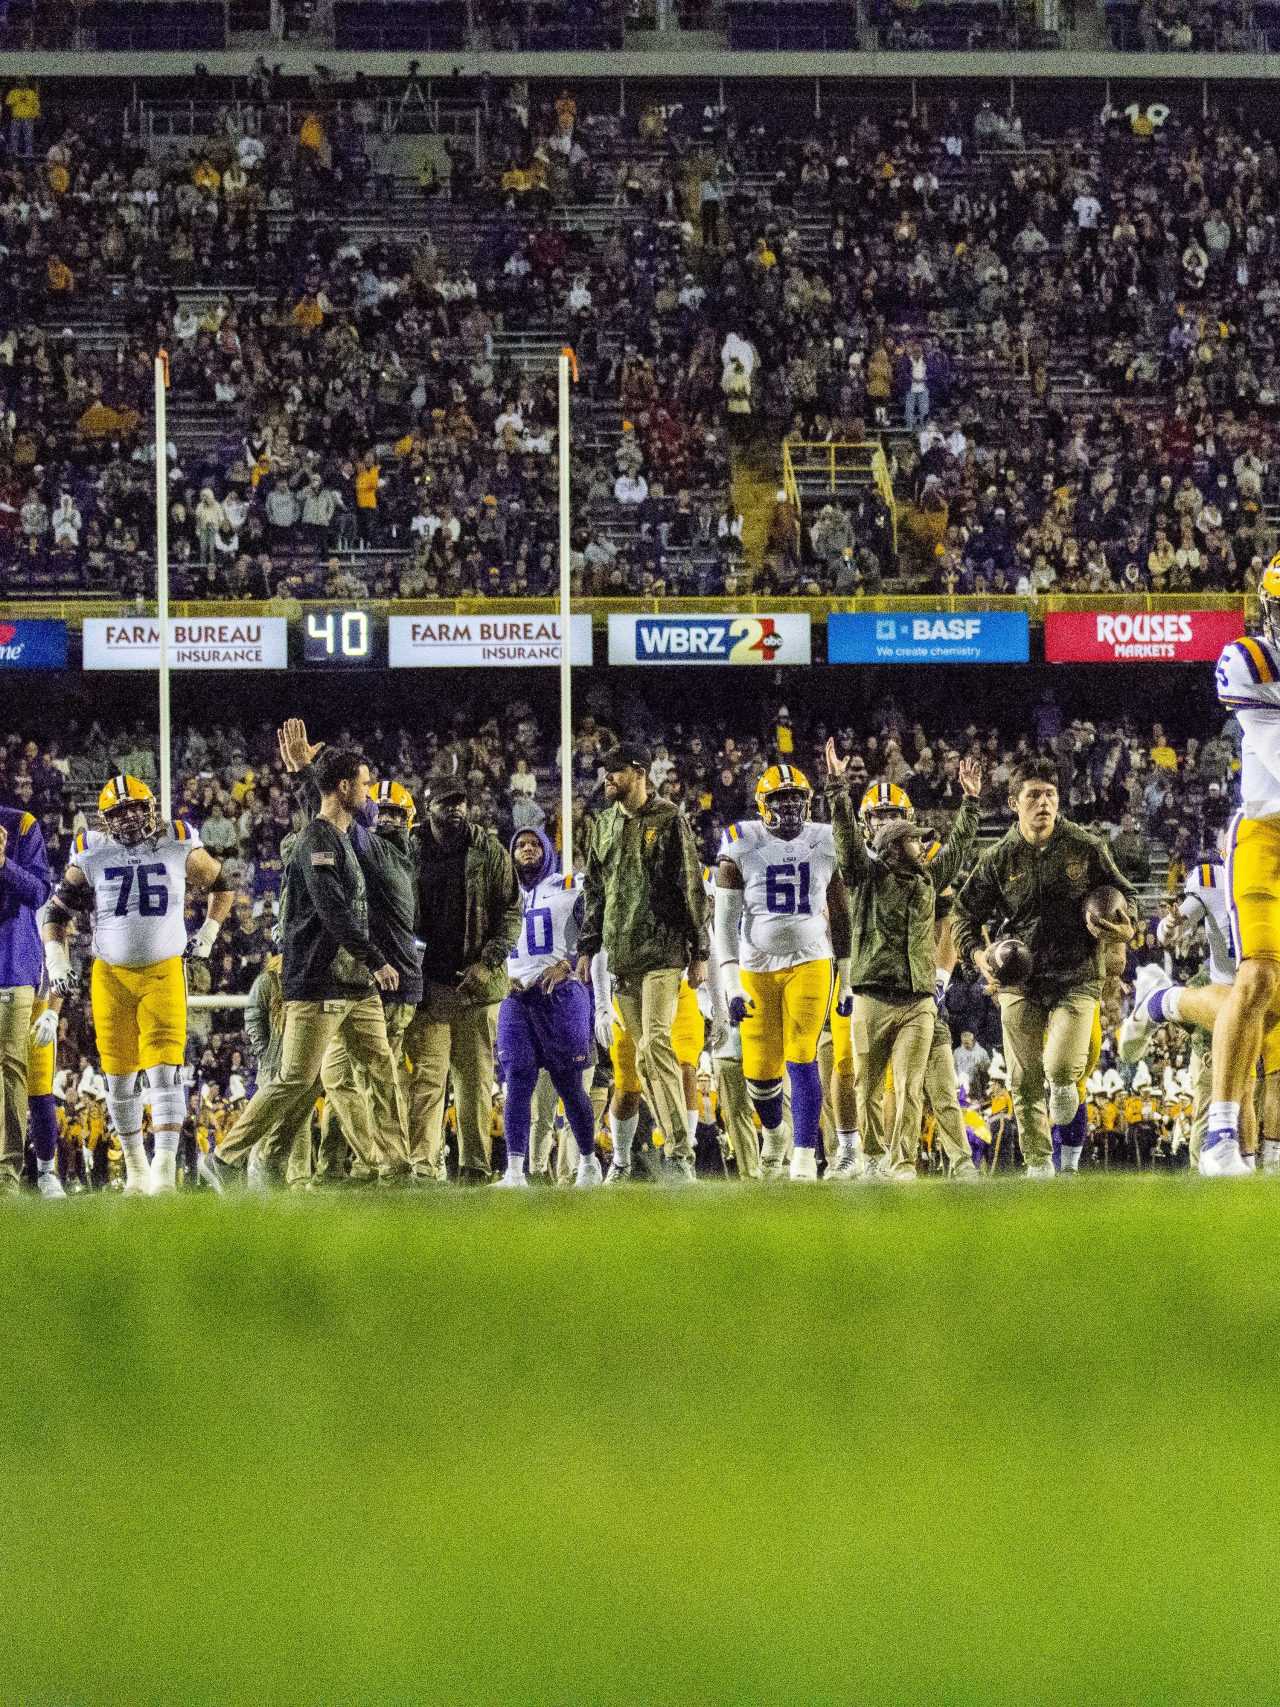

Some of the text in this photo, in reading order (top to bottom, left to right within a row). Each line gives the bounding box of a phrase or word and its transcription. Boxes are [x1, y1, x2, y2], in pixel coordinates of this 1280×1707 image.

[106, 625, 262, 644] FARM BUREAU
[308, 612, 367, 656] 40
[411, 623, 471, 641] FARM
[912, 620, 981, 640] BASF
[1097, 614, 1193, 645] ROUSES
[640, 618, 764, 665] WBRZ 2
[1115, 644, 1175, 658] MARKETS
[177, 649, 262, 662] INSURANCE
[482, 647, 562, 659] INSURANC
[876, 646, 981, 657] We create chemistry
[103, 863, 168, 917] 76
[766, 862, 811, 914] 61
